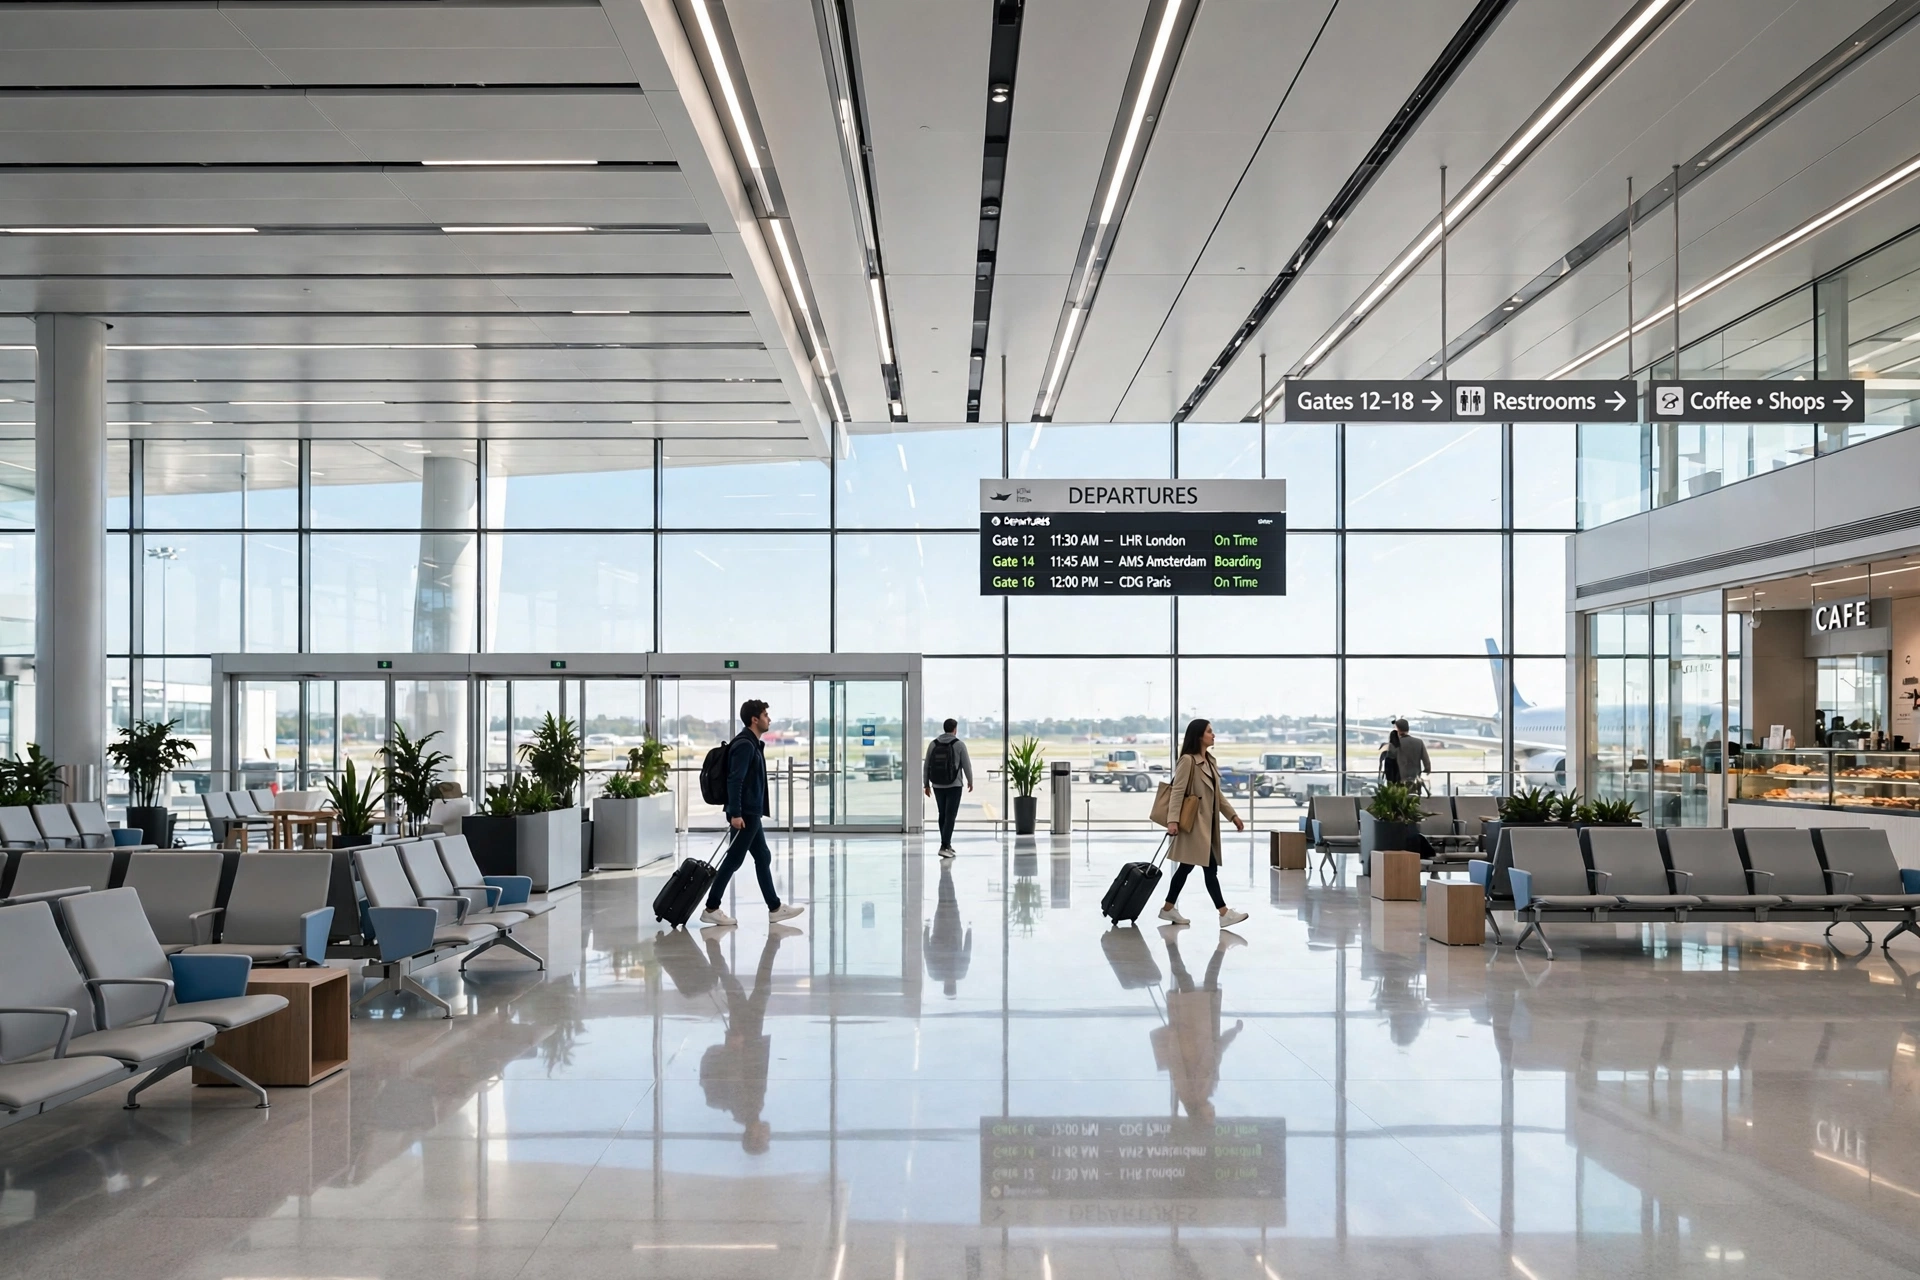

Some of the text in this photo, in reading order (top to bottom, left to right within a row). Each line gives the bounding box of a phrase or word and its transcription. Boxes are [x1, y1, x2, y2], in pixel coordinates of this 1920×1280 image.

[1297, 391, 1354, 411] Gates
[1493, 391, 1597, 411] Restrooms
[1690, 390, 1752, 411] Coffee
[1769, 391, 1826, 415] Shops
[1069, 487, 1198, 504] DEPARTURES
[992, 534, 1019, 547] Gate
[1022, 534, 1035, 547] 12
[1050, 534, 1079, 547] 11:30
[1081, 534, 1099, 547] AM
[1119, 534, 1143, 547] LHR
[1146, 534, 1186, 547] London
[1214, 534, 1230, 547] On
[1233, 534, 1258, 547] Time
[992, 555, 1019, 567] Gate
[1022, 555, 1035, 567] 14
[1050, 555, 1079, 567] 11:45
[1081, 555, 1099, 567] AM
[1118, 555, 1144, 567] AMS
[1146, 555, 1207, 567] Amsterdam
[1214, 555, 1262, 570] Boarding
[992, 576, 1019, 588] Gate
[1022, 576, 1035, 588] 16
[1050, 576, 1079, 588] 12:00
[1081, 576, 1099, 588] PM
[1119, 576, 1144, 588] CDG
[1146, 576, 1172, 588] Paris
[1214, 576, 1230, 588] On
[1233, 576, 1258, 588] Time
[1815, 601, 1867, 631] CAFE
